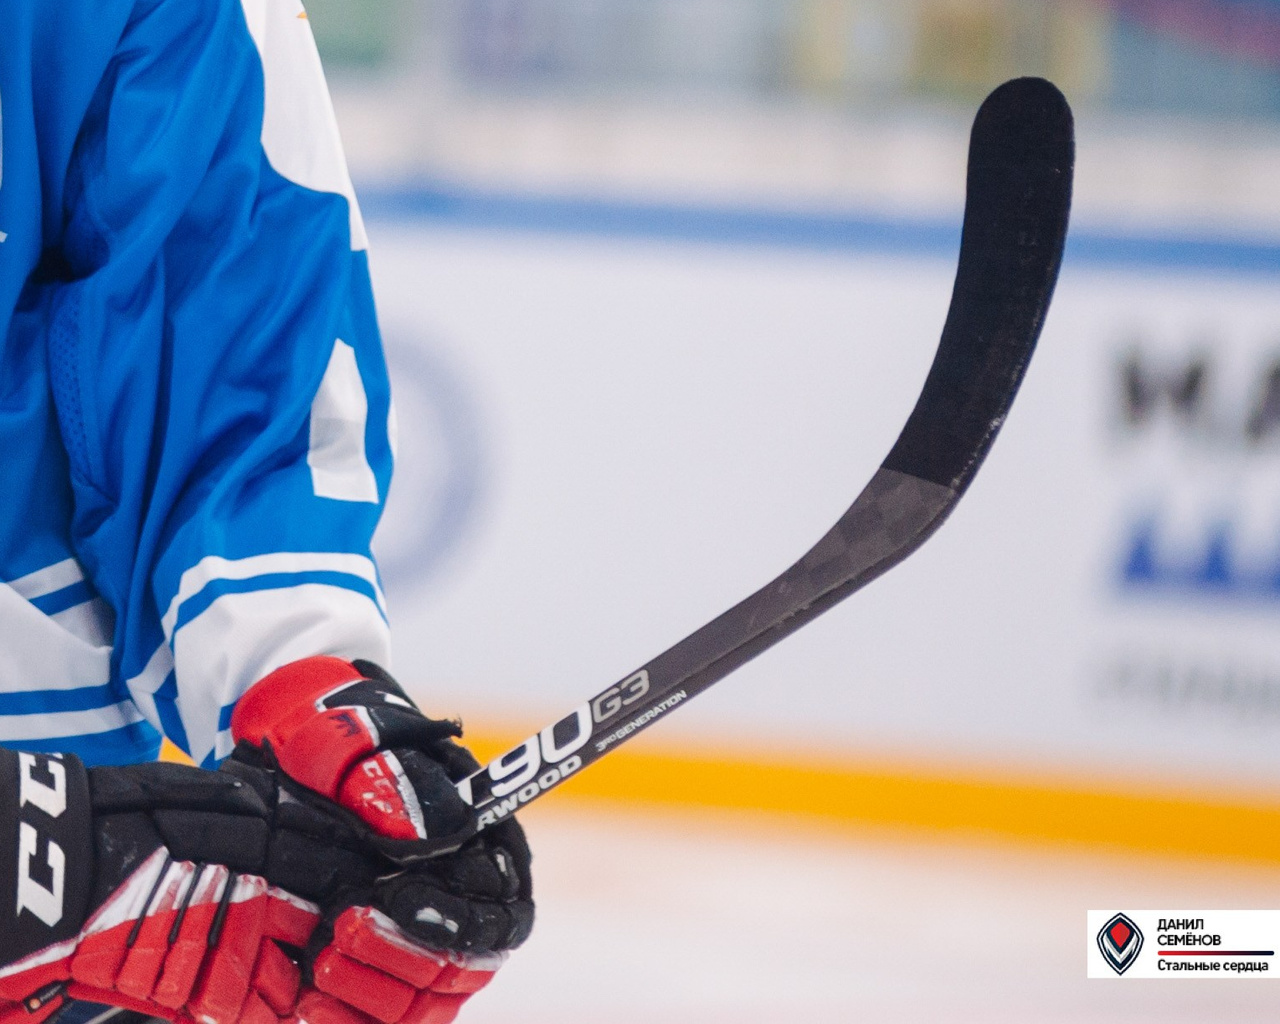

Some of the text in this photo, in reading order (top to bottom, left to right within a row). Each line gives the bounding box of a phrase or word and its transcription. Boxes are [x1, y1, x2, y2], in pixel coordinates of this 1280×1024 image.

[592, 669, 650, 724] G3
[616, 689, 688, 739] GENERATION
[476, 755, 582, 832] RWOOD
[17, 751, 67, 928] CC
